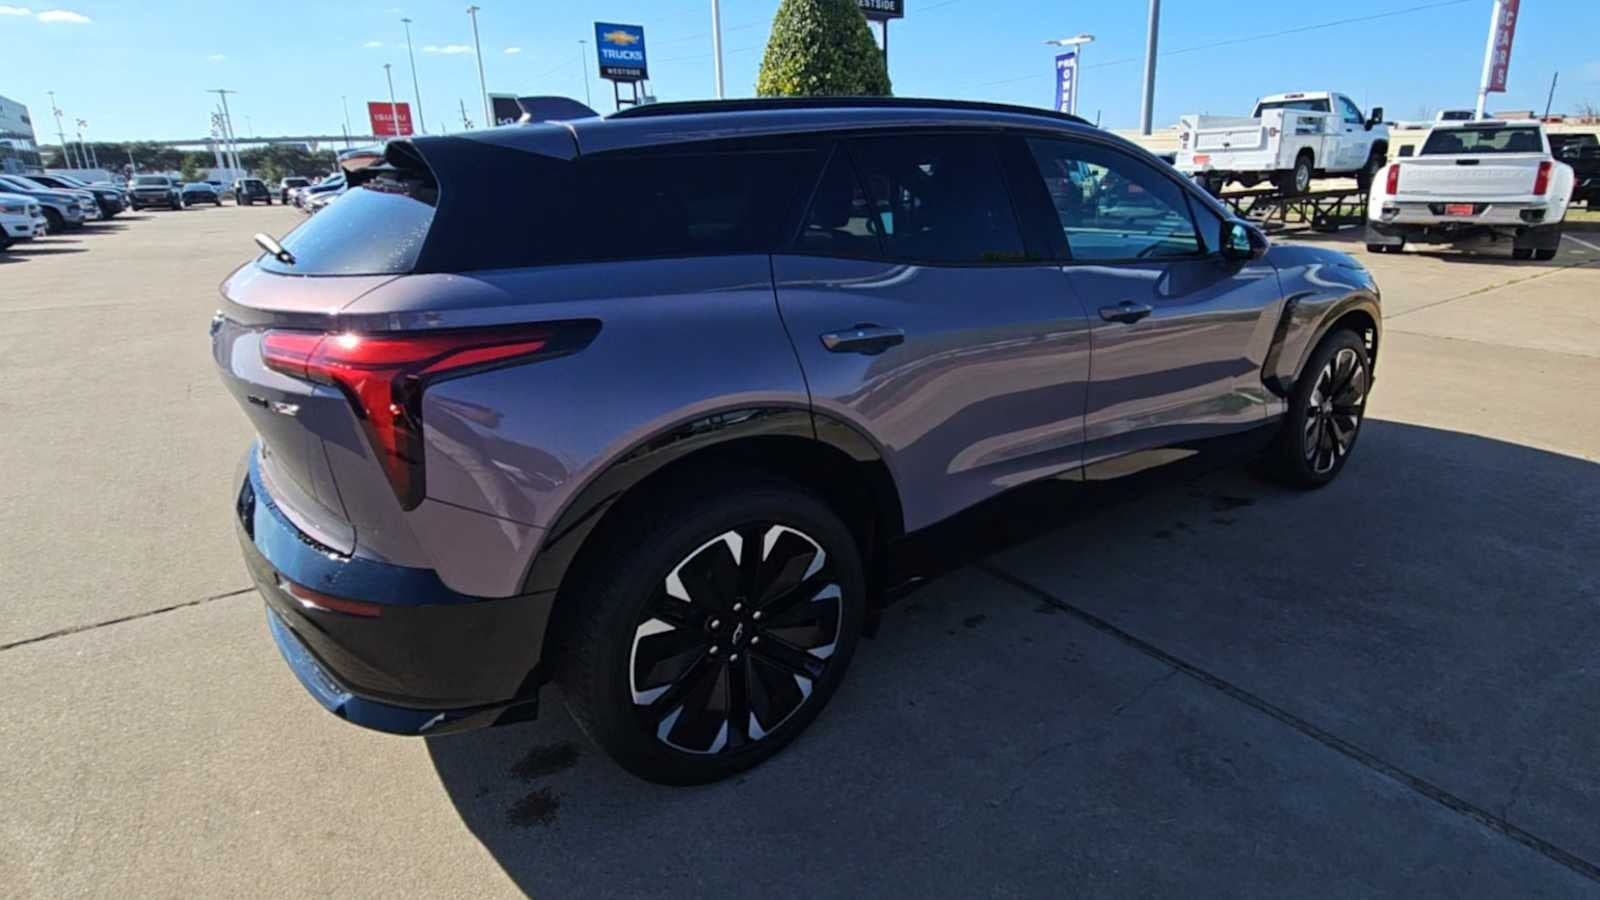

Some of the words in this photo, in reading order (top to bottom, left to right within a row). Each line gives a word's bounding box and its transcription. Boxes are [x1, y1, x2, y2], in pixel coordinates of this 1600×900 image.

[857, 0, 896, 10] ESTSIDE
[601, 48, 643, 60] TRUCKS
[1060, 69, 1071, 113] OWNE
